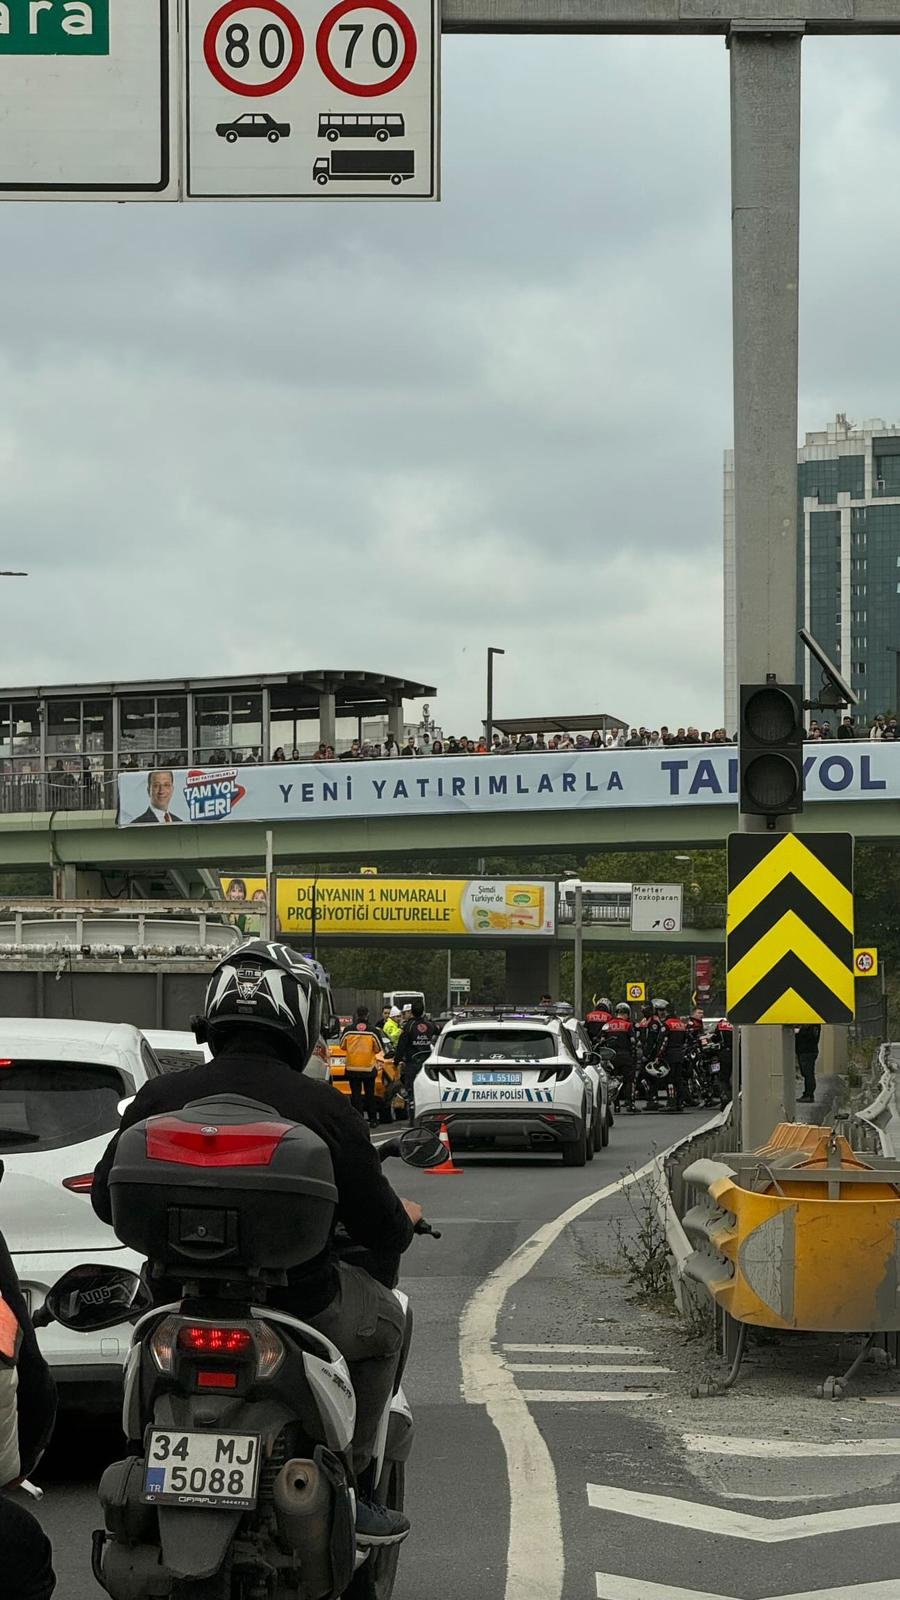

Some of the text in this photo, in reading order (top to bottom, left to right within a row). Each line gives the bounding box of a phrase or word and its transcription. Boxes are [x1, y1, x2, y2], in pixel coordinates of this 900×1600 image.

[225, 23, 285, 69] 80
[338, 23, 399, 69] 70
[184, 780, 239, 800] TAM YOL
[279, 771, 624, 803] YENİ YATIRIMLARLA
[660, 758, 738, 795] TA
[190, 793, 231, 819] İLERİ
[297, 886, 447, 902] DÜNYANIN 1 NUMARALI
[635, 894, 679, 902] Tozkoparan
[287, 904, 369, 921] PROBİYOTİĞİ
[472, 1089, 524, 1100] TRAFİK POLİSİ
[153, 1434, 254, 1465] 34 MJ
[149, 1466, 244, 1495] TR 5088
